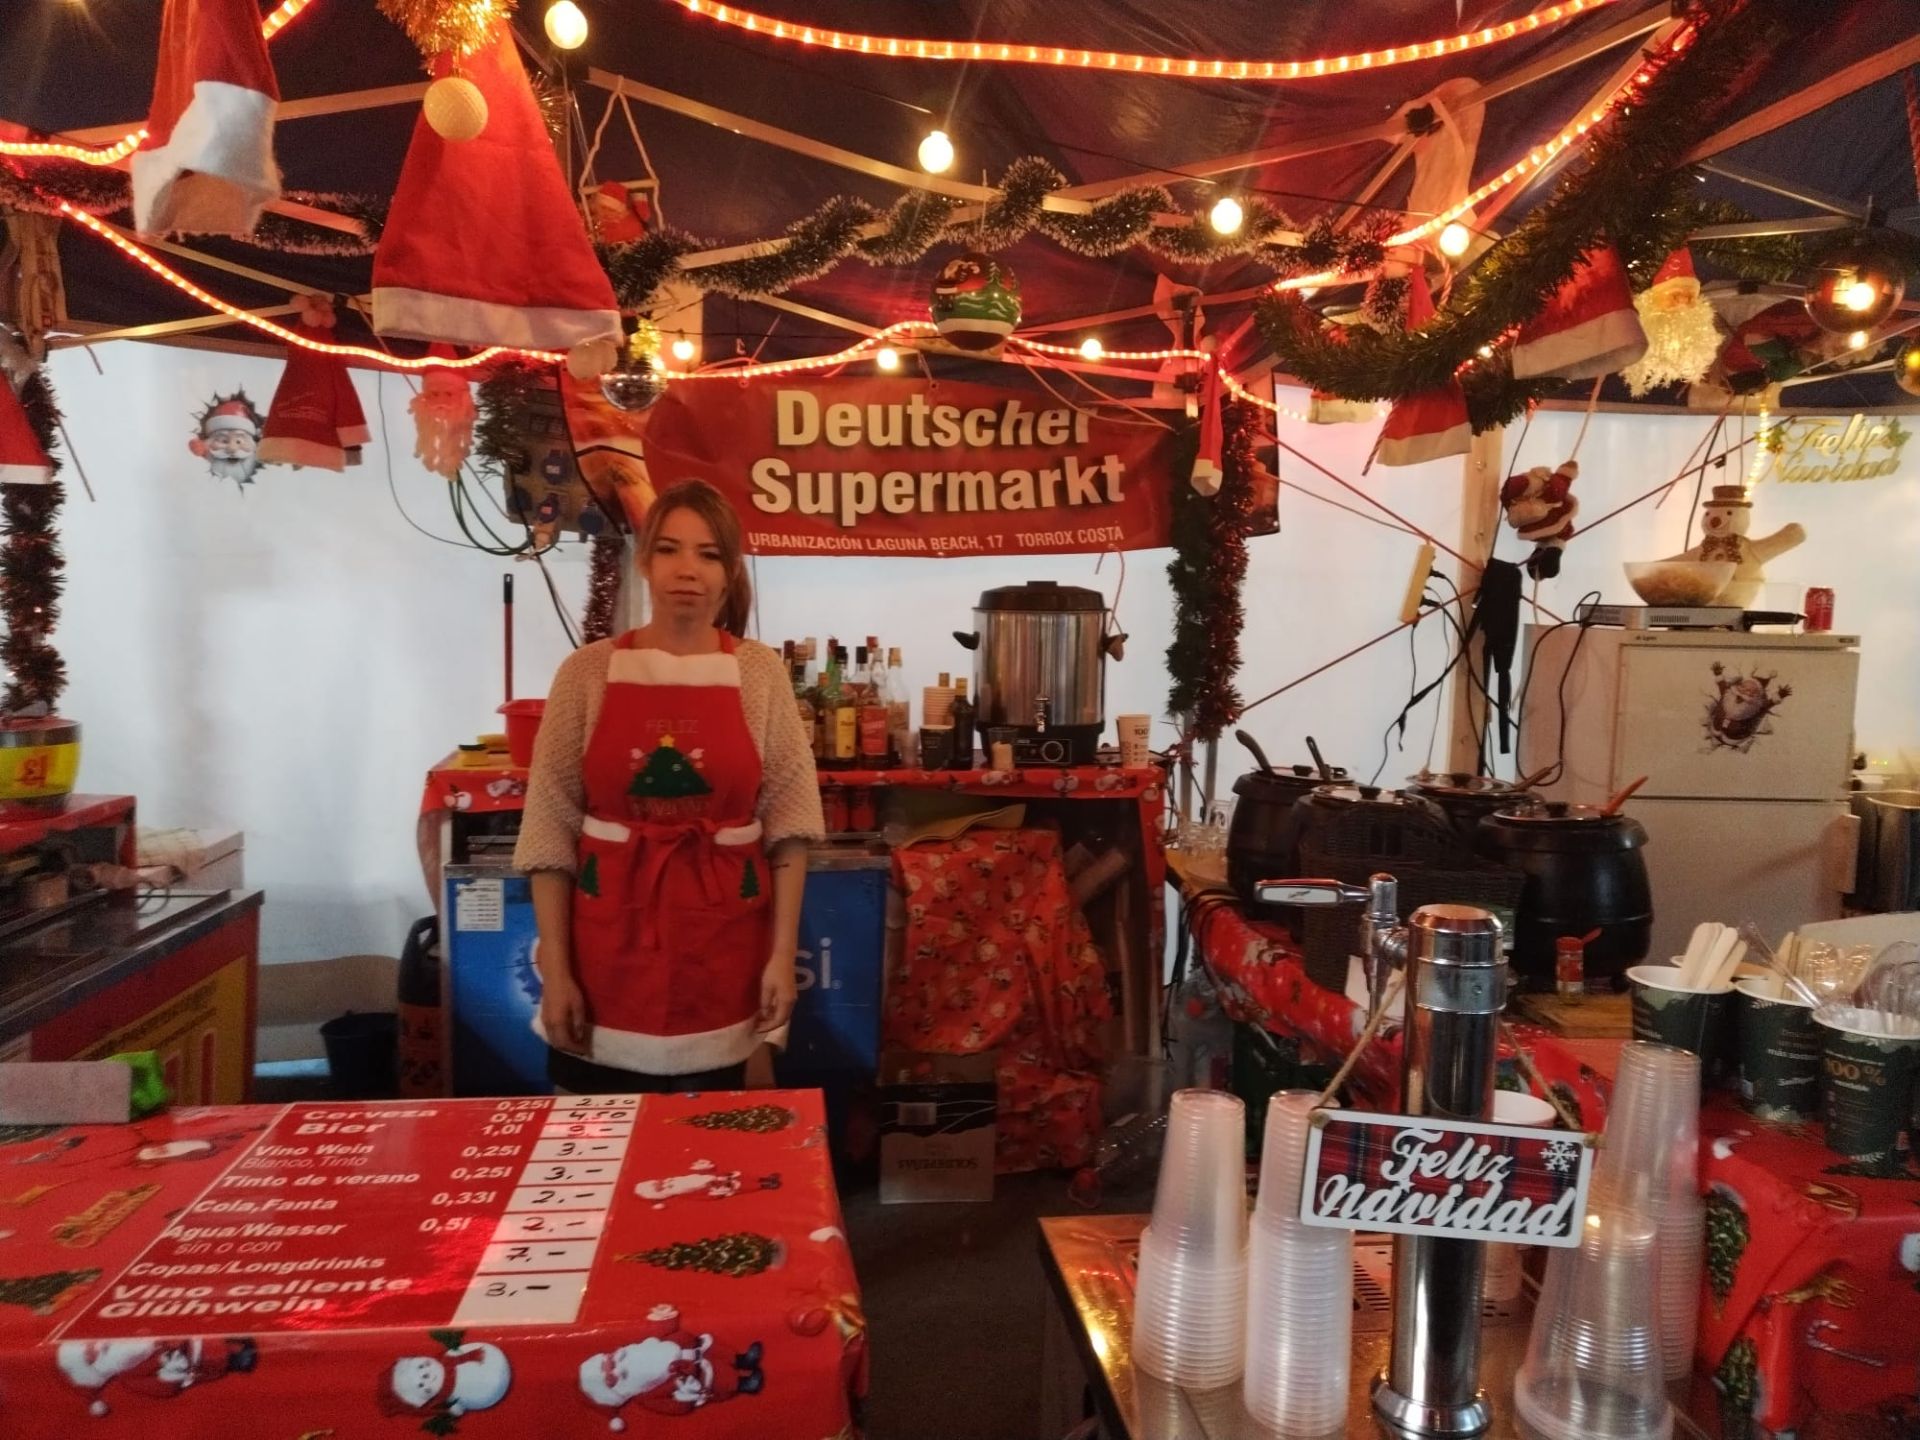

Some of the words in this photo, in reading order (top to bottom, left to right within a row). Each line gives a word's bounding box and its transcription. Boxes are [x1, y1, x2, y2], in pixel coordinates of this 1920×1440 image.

[776, 389, 1096, 448] Deutscher
[750, 453, 1127, 527] Supermarkt
[749, 532, 862, 551] URBANIZACIÓN
[866, 537, 928, 551] LAGUNA
[930, 536, 984, 551] BEACH,
[987, 535, 1004, 548] 17
[1016, 531, 1075, 548] TORROX
[1078, 526, 1125, 544] COSTA
[496, 1099, 550, 1111] 0,25l
[303, 1108, 439, 1120] Cerveza
[490, 1111, 535, 1123] 0,5l
[295, 1122, 386, 1135] Bier
[255, 1145, 309, 1156] Vino
[315, 1144, 375, 1155] Wein
[461, 1145, 521, 1158] 0,25l
[1380, 1128, 1514, 1183] Feliz
[320, 1156, 369, 1167] Tinto
[221, 1173, 288, 1188] Tinto
[292, 1173, 328, 1187] de
[334, 1172, 420, 1185] verano
[450, 1166, 513, 1180] 0,25l
[431, 1191, 497, 1206] 0,33l
[419, 1217, 472, 1234] 0,5l
[174, 1241, 212, 1255] sin
[213, 1242, 234, 1252] o
[237, 1241, 283, 1253] con
[127, 1255, 386, 1278] Copas/Longdrinks
[113, 1283, 214, 1300] Vino
[227, 1277, 414, 1297] caliente
[99, 1296, 327, 1318] Glühwein
